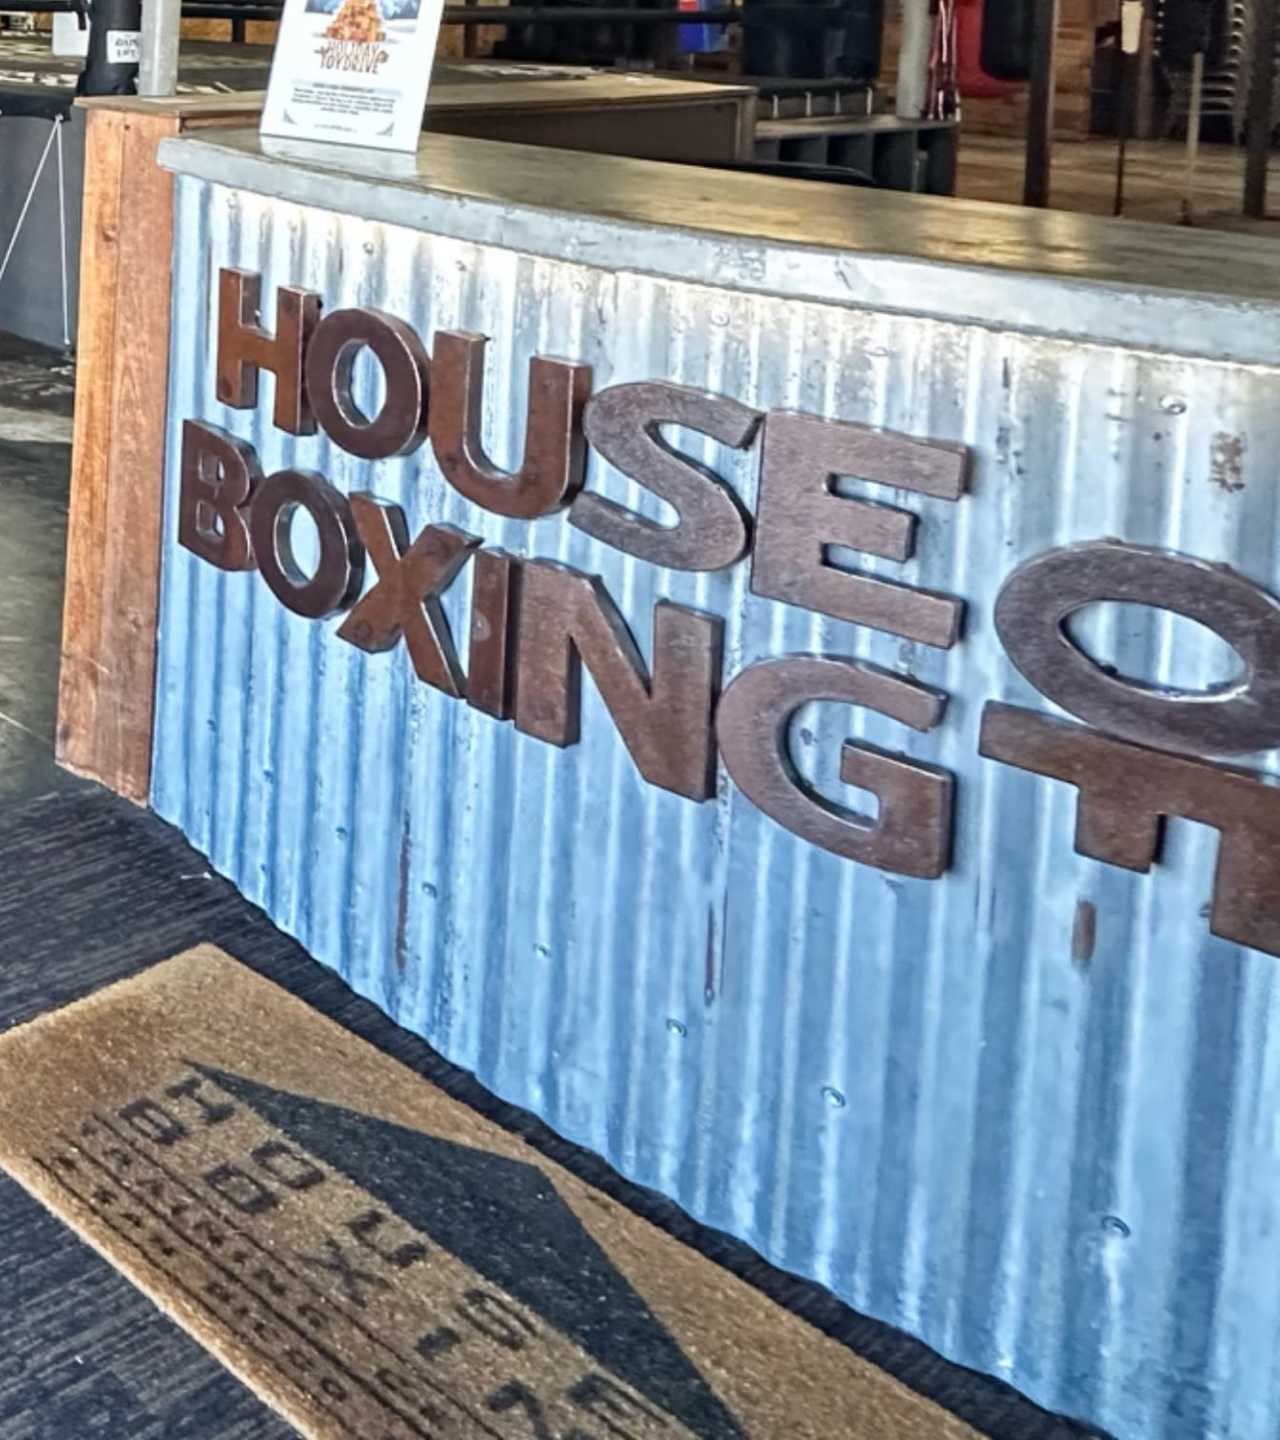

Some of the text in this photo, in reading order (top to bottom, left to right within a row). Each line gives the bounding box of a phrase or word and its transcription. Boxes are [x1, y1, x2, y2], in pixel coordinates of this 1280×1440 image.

[178, 418, 957, 880] BOXING
[214, 266, 972, 650] HOUSE
[166, 1077, 673, 1440] HOUSE
